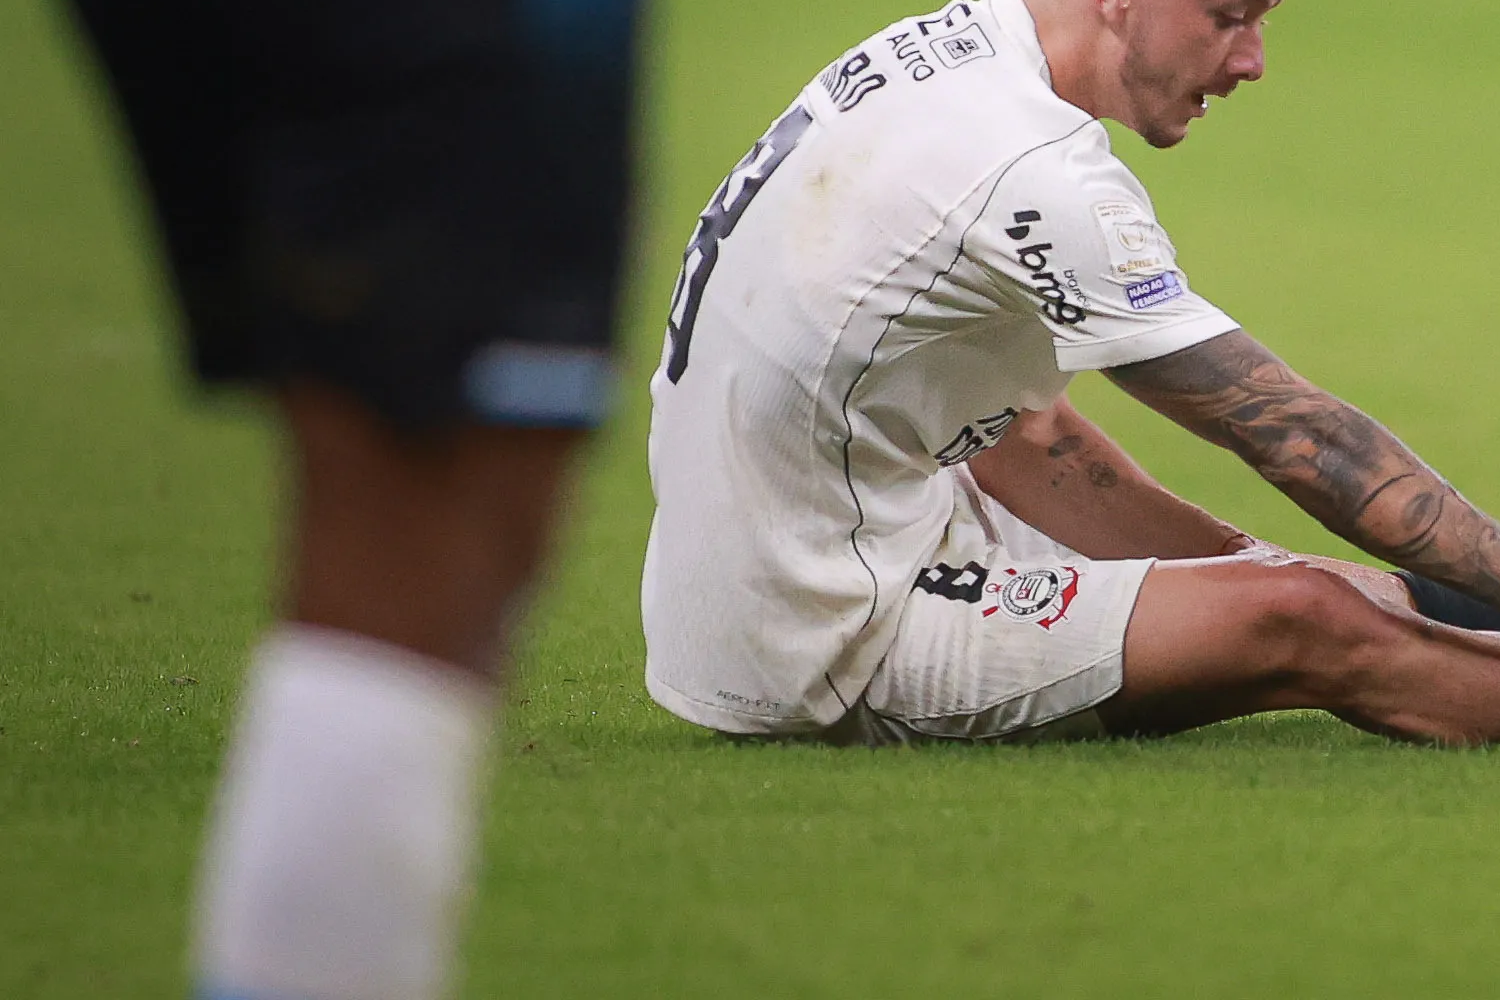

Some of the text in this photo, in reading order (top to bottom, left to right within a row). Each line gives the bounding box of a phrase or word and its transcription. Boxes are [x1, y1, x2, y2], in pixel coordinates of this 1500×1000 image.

[886, 31, 936, 83] AUTO
[1016, 242, 1087, 325] bmg
[1128, 278, 1164, 298] NÃO AO
[911, 560, 990, 605] 8
